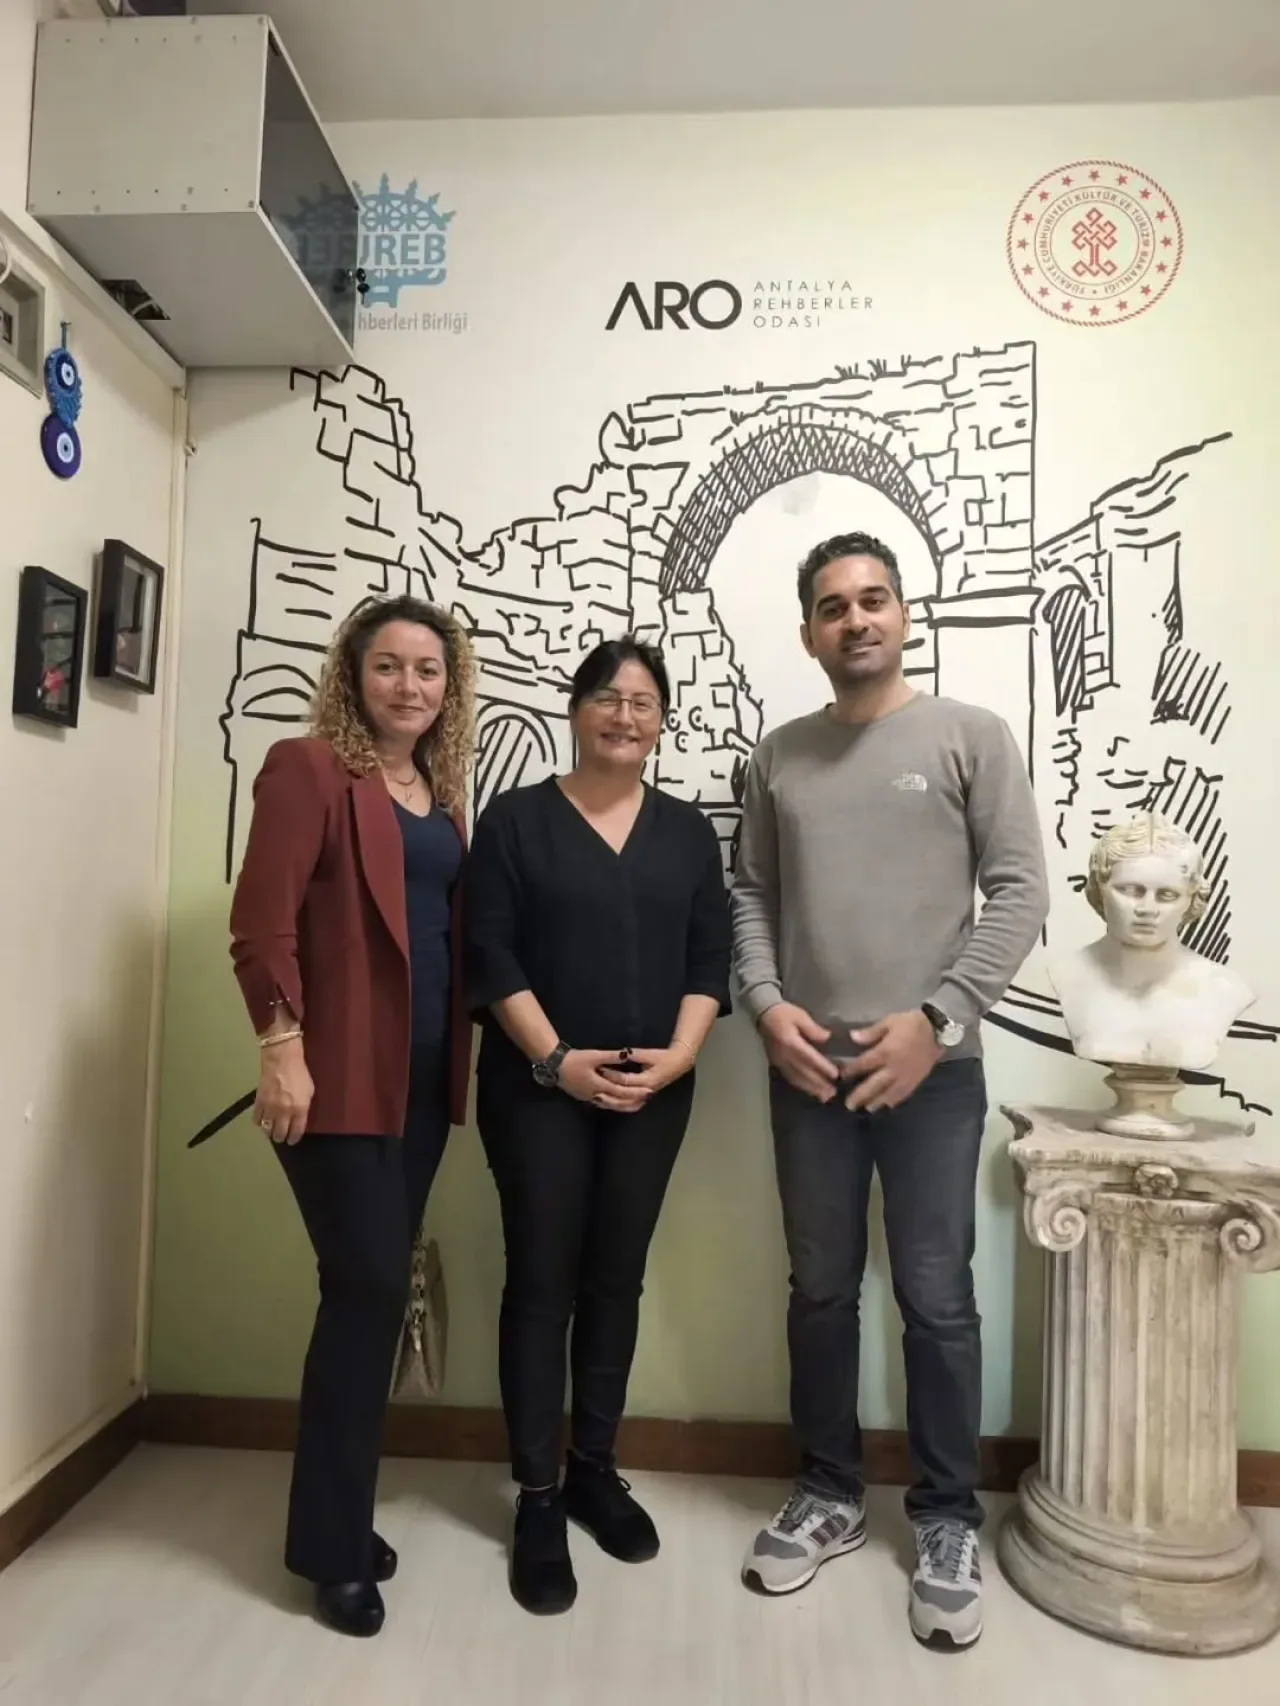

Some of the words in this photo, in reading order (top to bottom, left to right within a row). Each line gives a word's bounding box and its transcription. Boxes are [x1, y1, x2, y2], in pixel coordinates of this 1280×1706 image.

[753, 280, 852, 292] ANTALYA
[605, 280, 742, 330] ARO
[753, 297, 873, 310] REHBERLER
[422, 313, 468, 334] Birliği
[753, 315, 820, 328] ODASI
